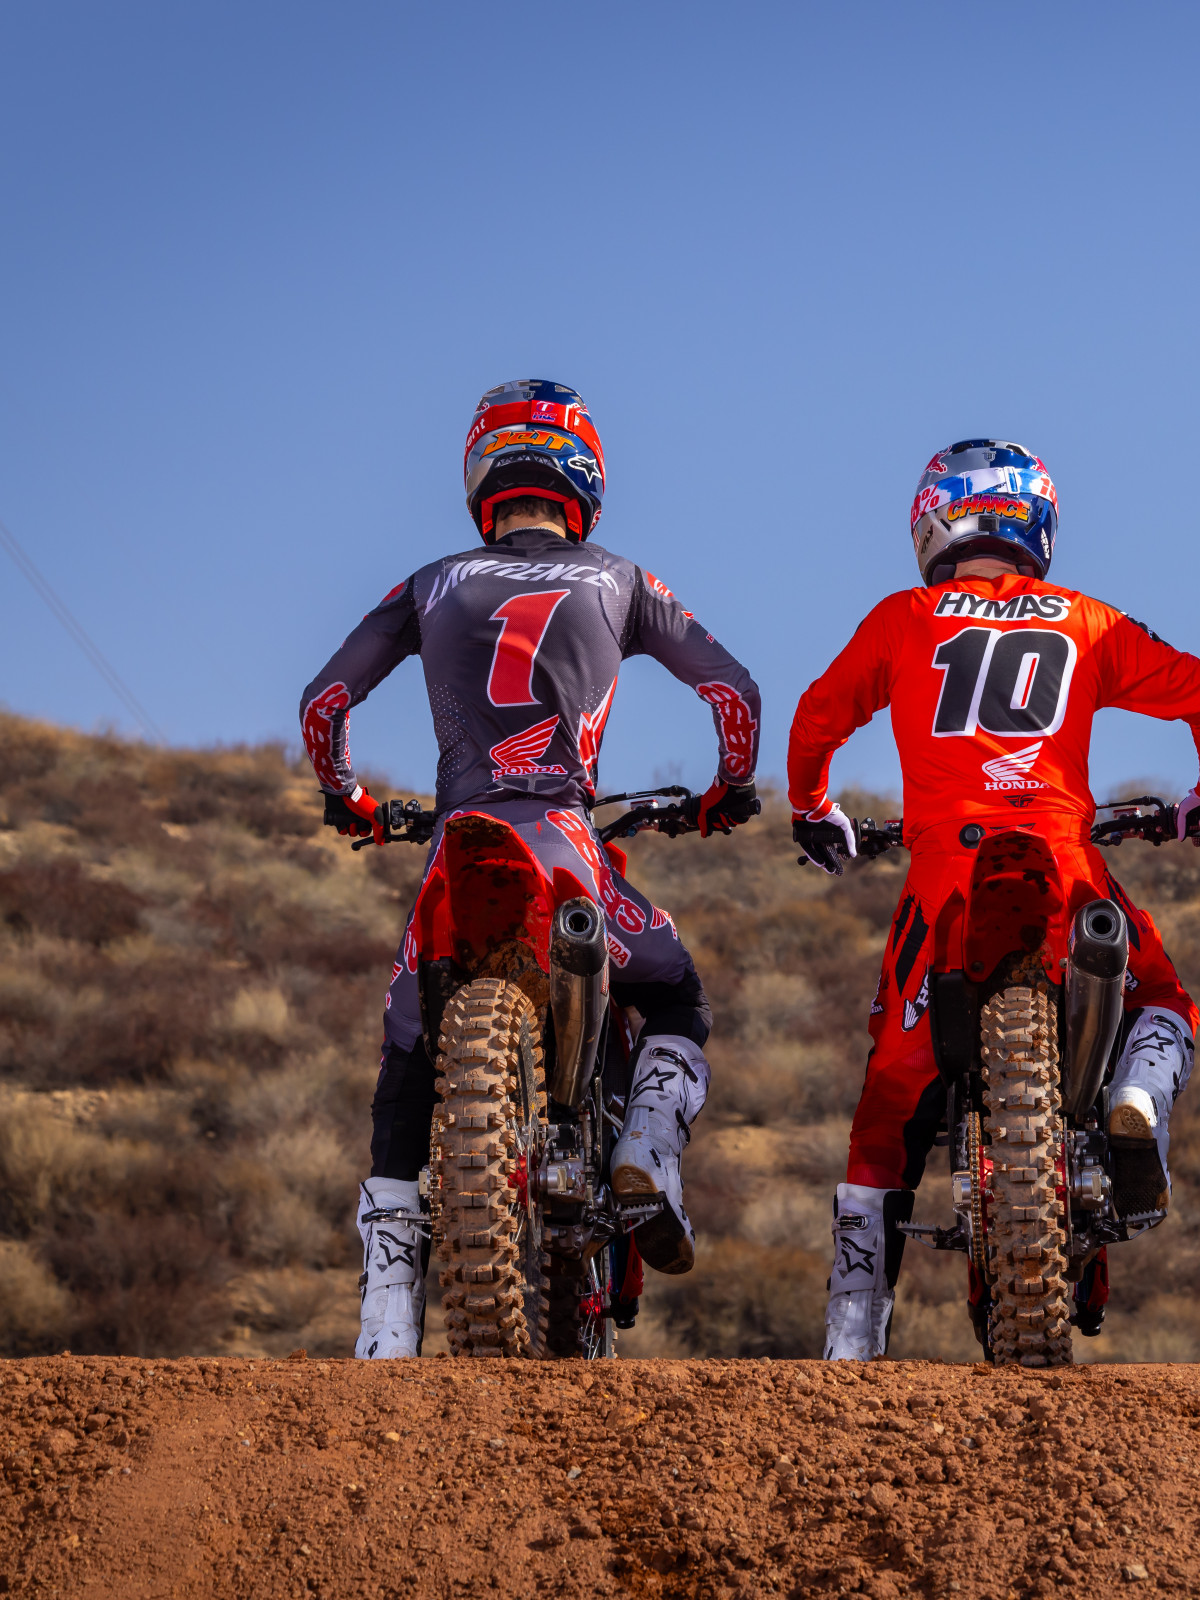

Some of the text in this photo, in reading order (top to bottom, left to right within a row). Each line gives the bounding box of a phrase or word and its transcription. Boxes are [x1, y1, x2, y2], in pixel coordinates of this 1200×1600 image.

[947, 494, 1032, 524] CHANCE
[933, 591, 1072, 622] HYMAS
[487, 588, 572, 708] 1
[930, 626, 1078, 739] 10
[493, 763, 569, 782] HONDA
[984, 779, 1052, 791] HONDA
